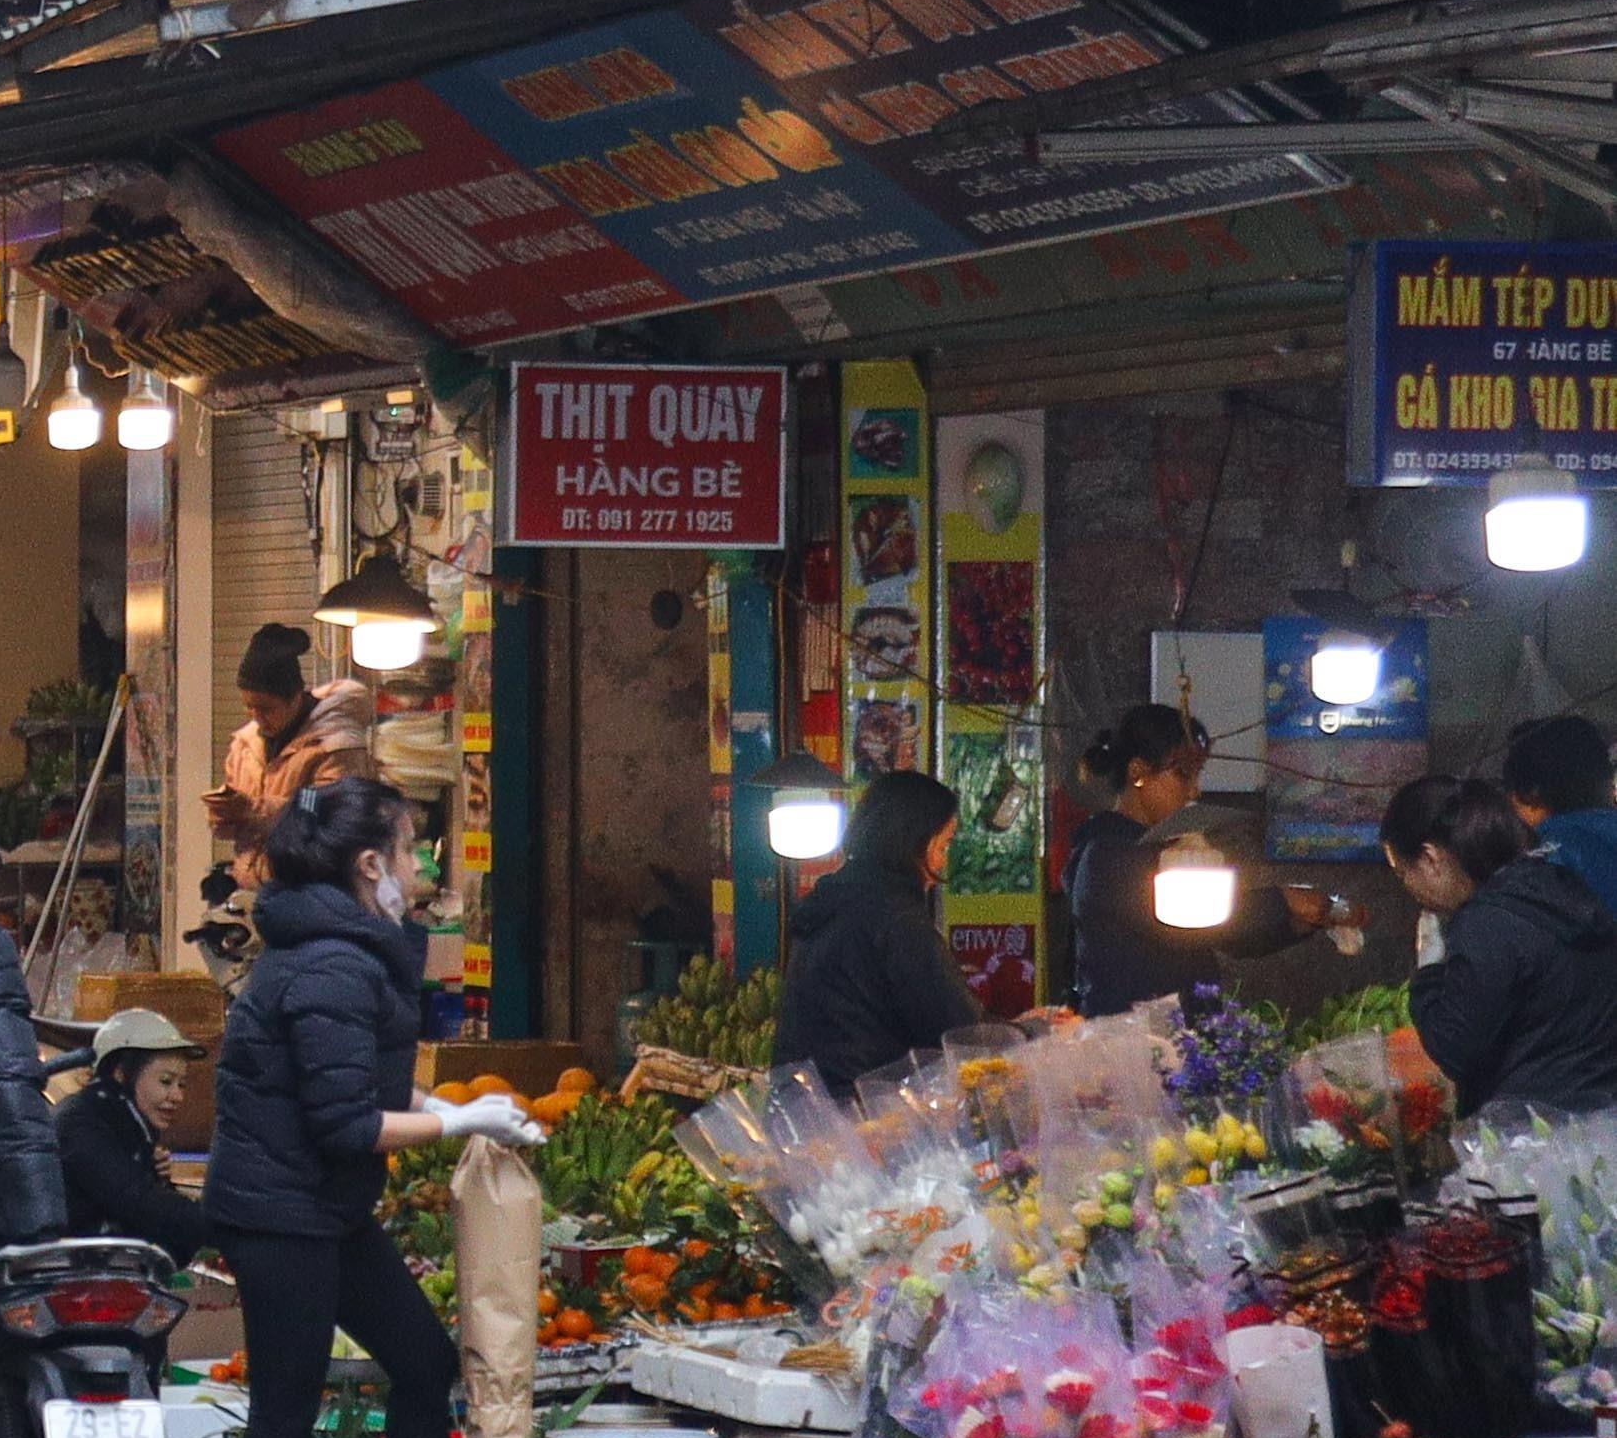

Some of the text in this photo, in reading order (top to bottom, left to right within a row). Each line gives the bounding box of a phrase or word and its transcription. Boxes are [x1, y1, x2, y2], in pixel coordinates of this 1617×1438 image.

[1398, 254, 1483, 328] MẮM
[1493, 263, 1554, 329] TÉP
[1493, 341, 1517, 361] 67
[535, 383, 765, 453] THỊT QUAY
[1396, 363, 1440, 430] CÁ
[1450, 375, 1516, 430] KHO
[1529, 375, 1580, 431] GIA
[556, 457, 742, 498] HÀNG BÈ
[598, 509, 633, 531] 091
[640, 510, 677, 532] 277
[686, 511, 733, 532] 1925
